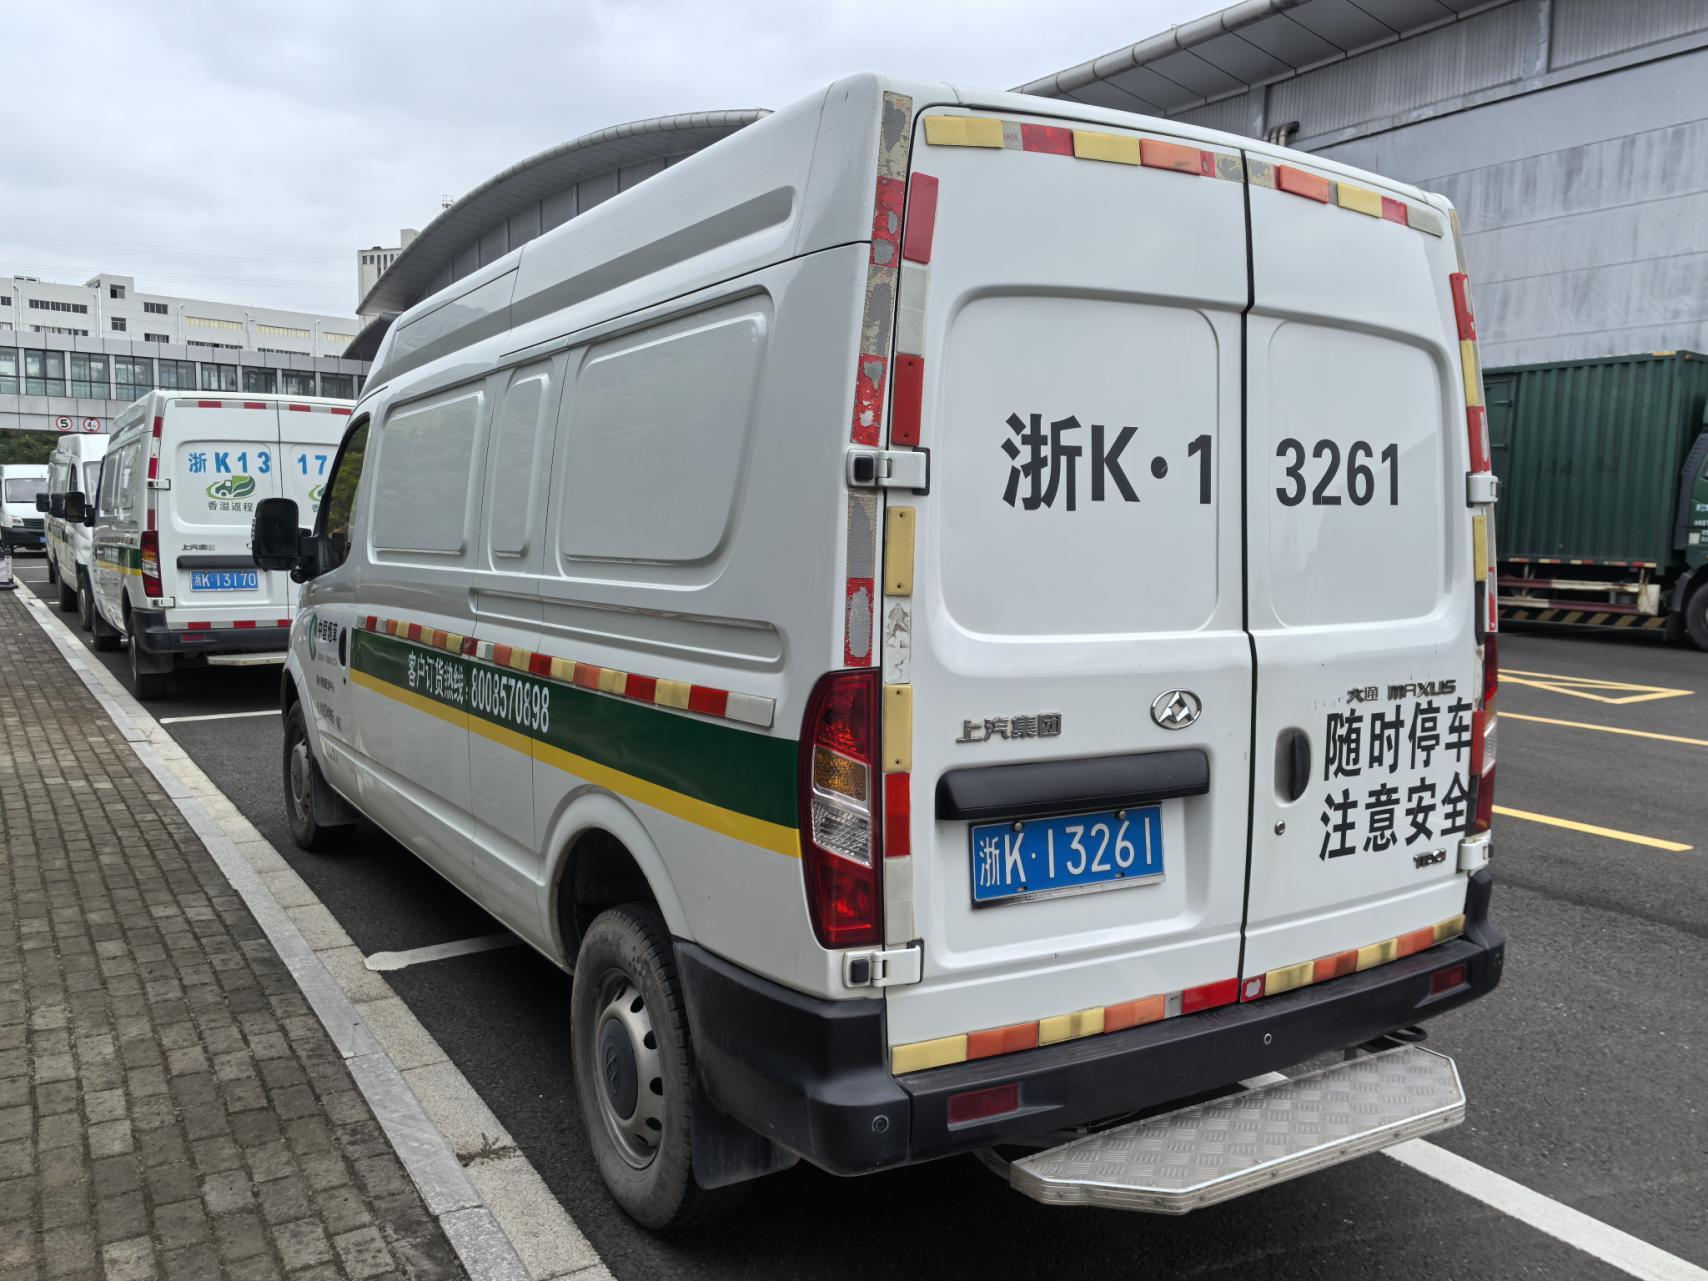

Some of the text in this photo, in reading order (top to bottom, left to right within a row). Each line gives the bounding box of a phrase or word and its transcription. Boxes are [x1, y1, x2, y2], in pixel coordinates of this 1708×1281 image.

[60, 419, 68, 428] 5
[1275, 438, 1399, 508] 3261
[207, 501, 254, 512] 香溢返程
[1347, 679, 1457, 704] 大通 MAXUS
[955, 712, 1062, 744] 上汽集团
[1323, 696, 1473, 782] 随时停车
[1318, 771, 1469, 862] 注意安全
[979, 816, 1153, 888] 浙K·13261
